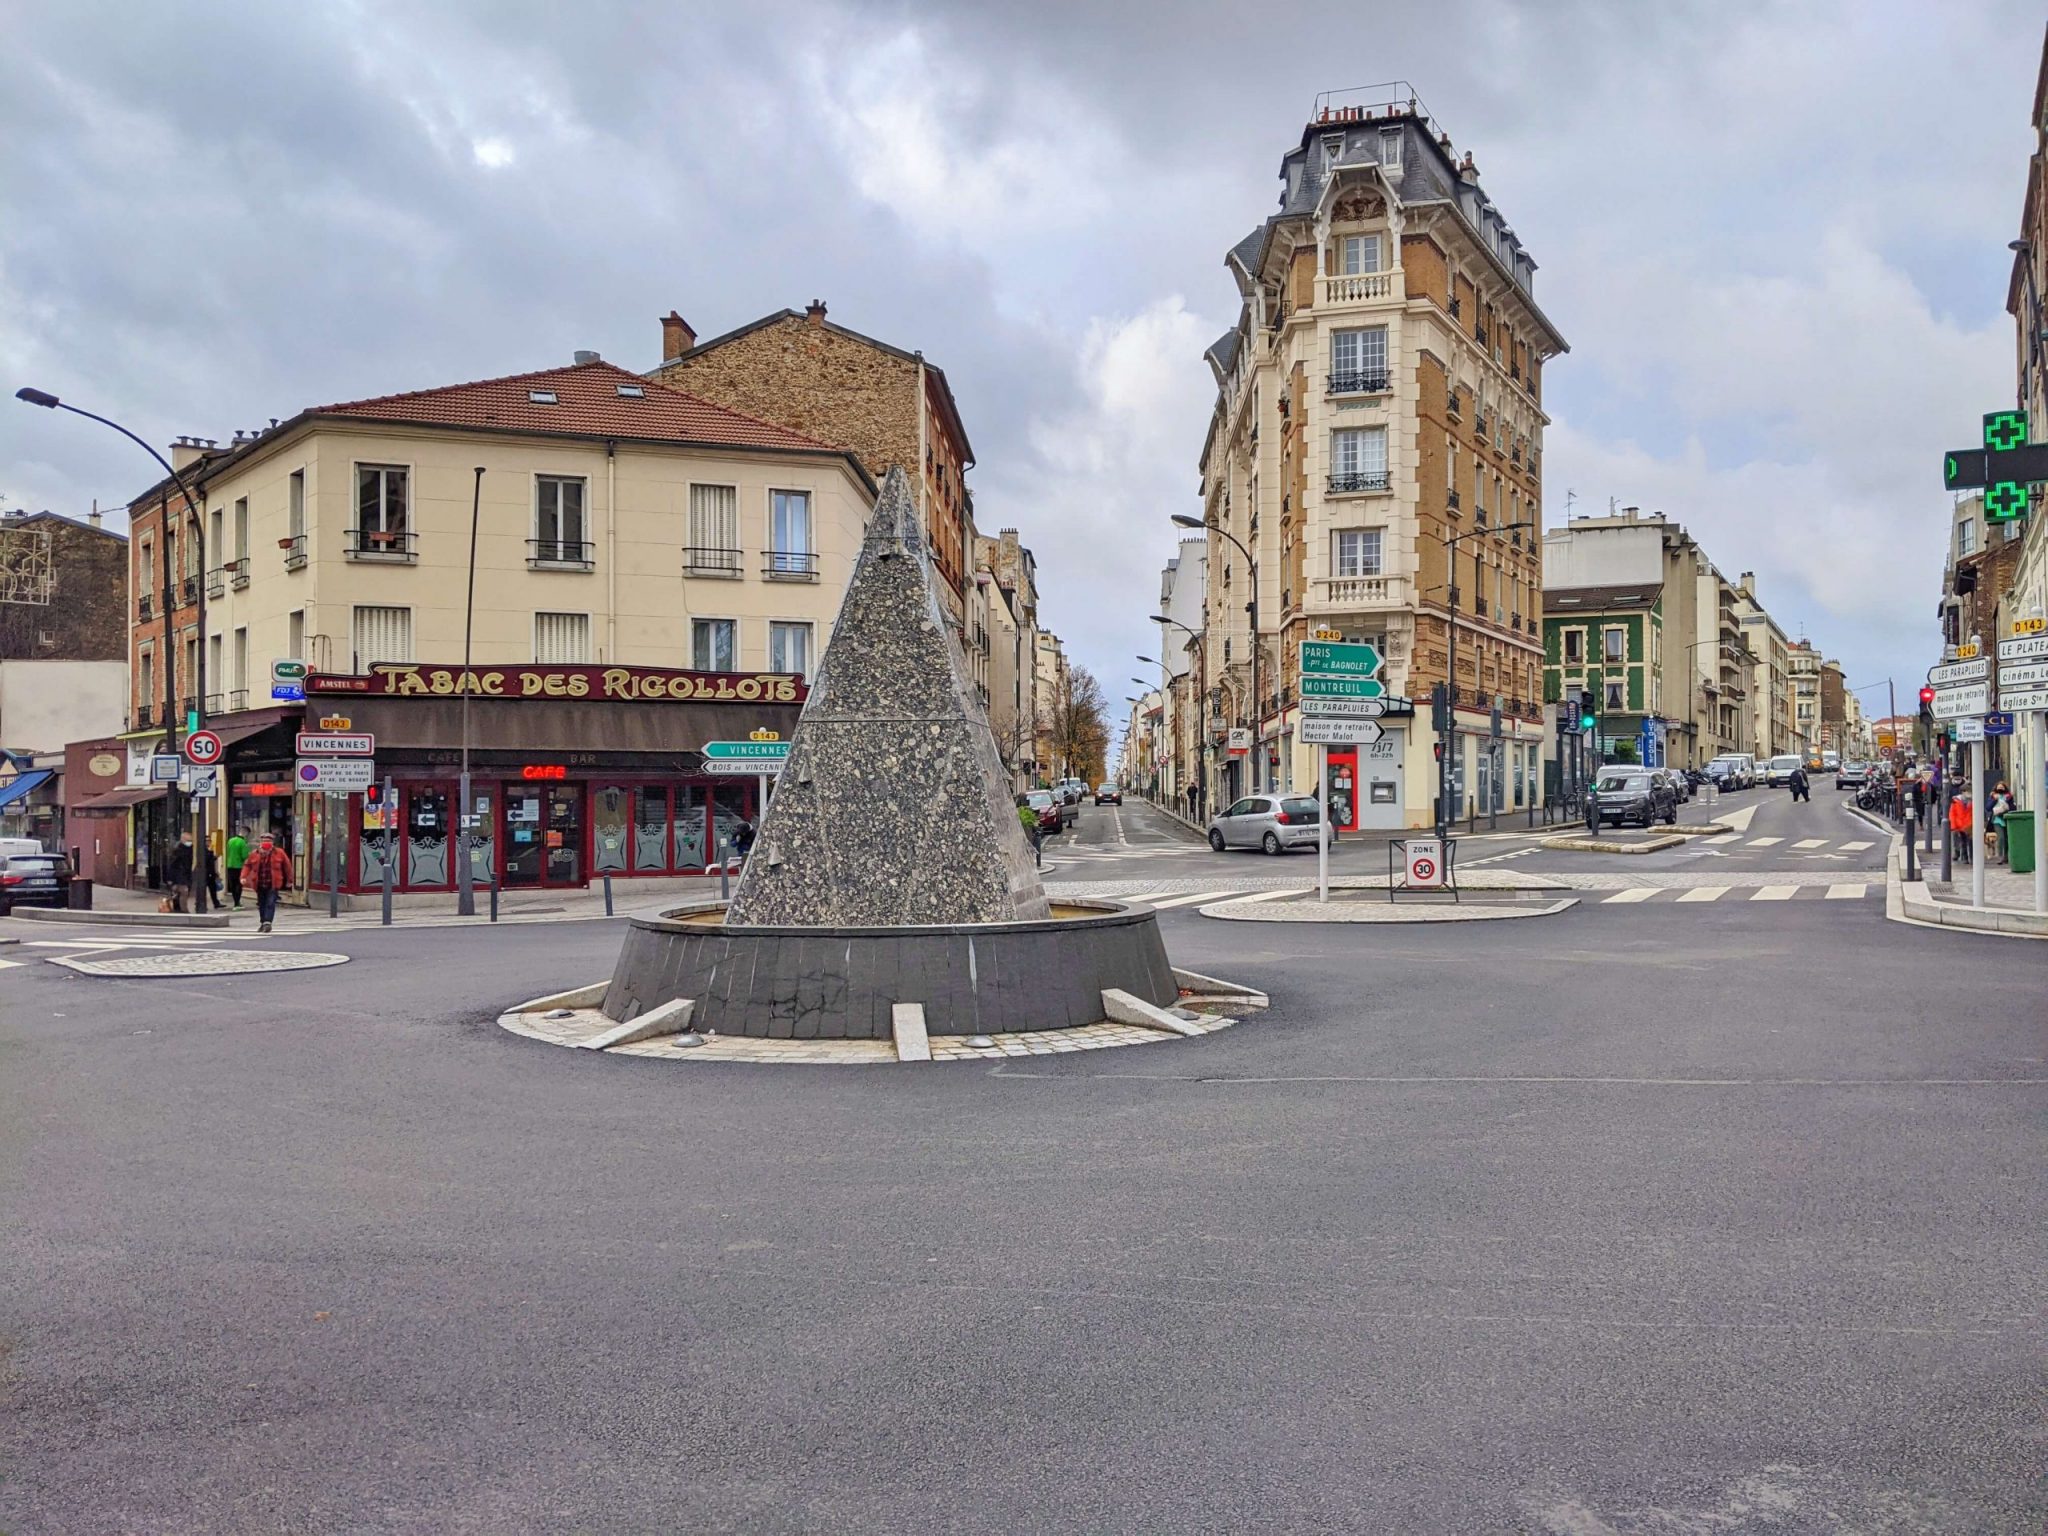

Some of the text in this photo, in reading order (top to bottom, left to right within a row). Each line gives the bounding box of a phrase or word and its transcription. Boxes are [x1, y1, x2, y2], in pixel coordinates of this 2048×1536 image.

[1305, 647, 1331, 658] PARIS
[2002, 644, 2012, 656] LE
[1330, 660, 1368, 670] BAGNOLET
[1938, 663, 1985, 680] LES PARAPLUIES
[2002, 669, 2035, 681] cinéma
[319, 680, 351, 689] AMSTEL
[374, 665, 797, 700] TABAC DES RIGOLLOTS
[1305, 681, 1362, 693] MONTREUIL
[1937, 688, 1985, 703] maison de retraite
[1304, 702, 1370, 713] LES PARAPLUIES
[1936, 702, 1971, 715] Hector Malot
[2003, 697, 2028, 710] église
[1304, 721, 1331, 729] maison
[1345, 723, 1373, 731] retraite
[1304, 731, 1353, 741] Hector Malot
[193, 740, 215, 754] 50
[304, 740, 367, 749] VINCENNES
[729, 746, 788, 755] VINCENNES
[571, 754, 596, 764] BAR
[712, 763, 732, 771] BOIS
[198, 781, 208, 789] 30
[1412, 846, 1434, 854] ZONE
[1417, 864, 1431, 874] 30
